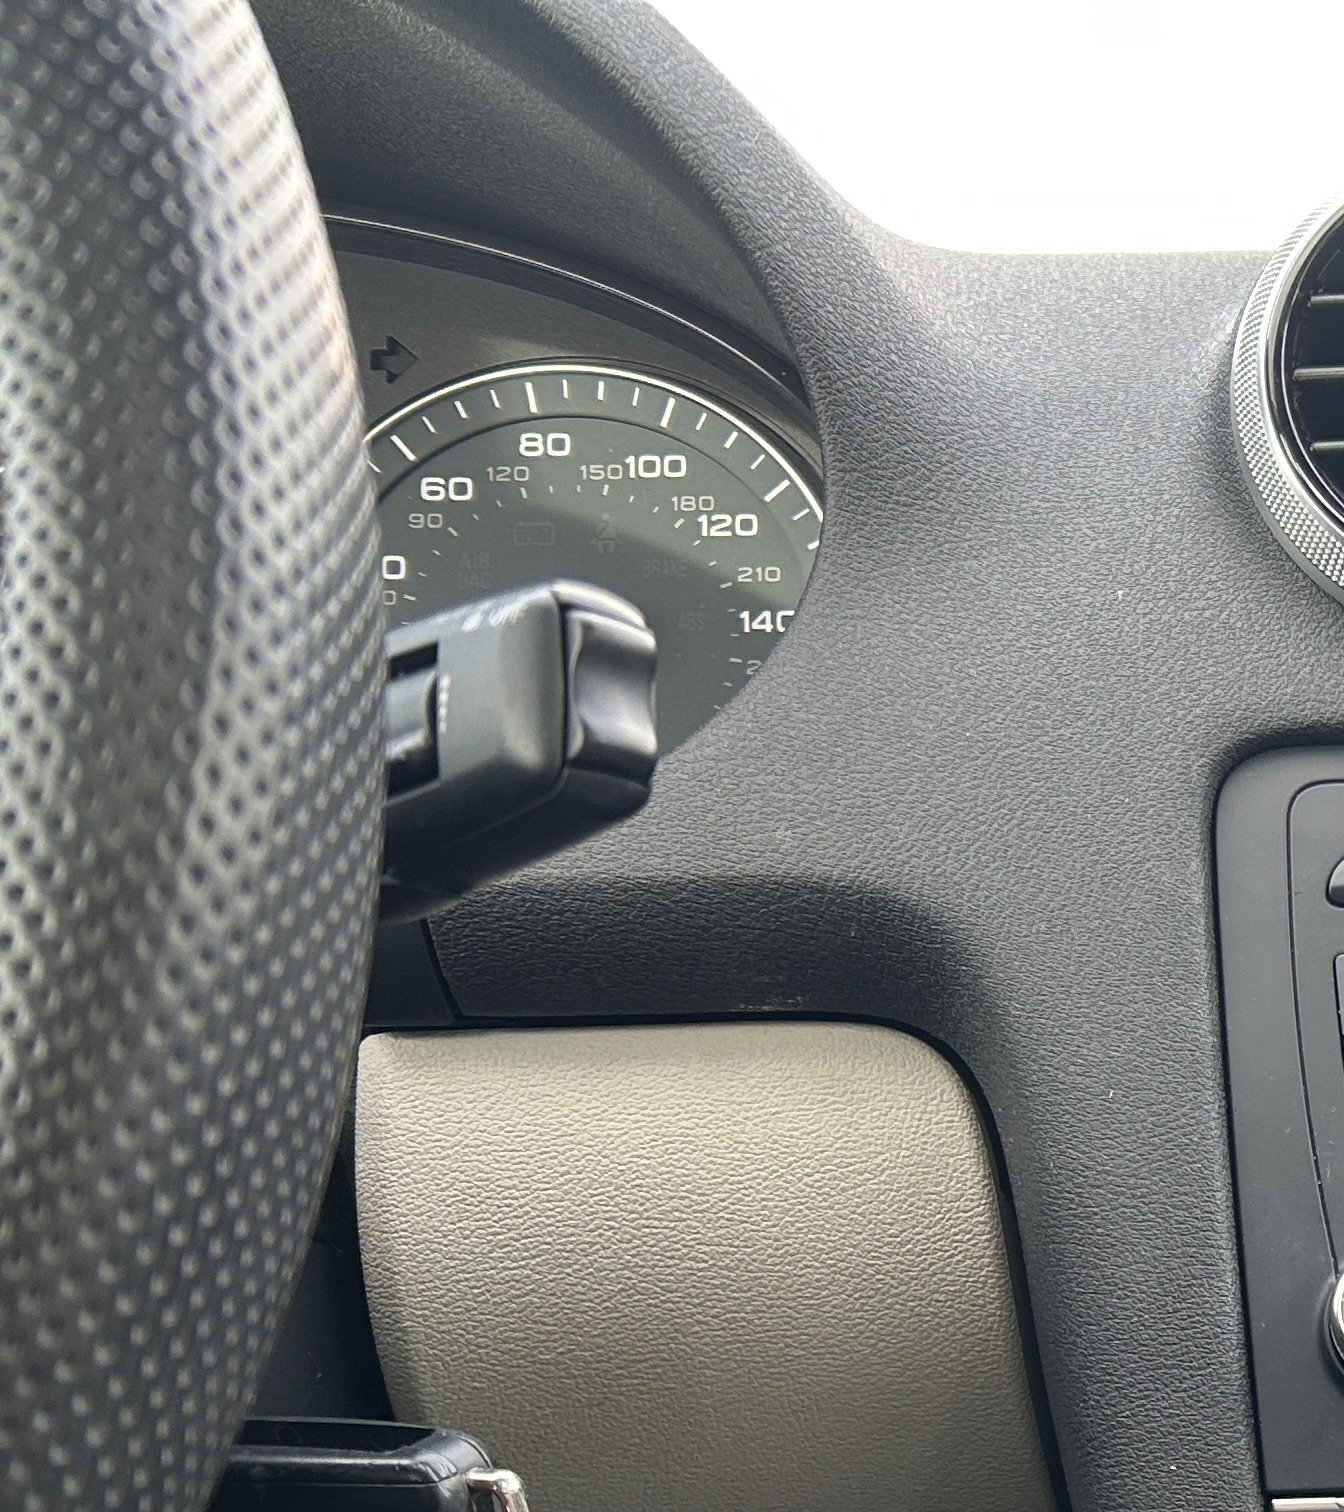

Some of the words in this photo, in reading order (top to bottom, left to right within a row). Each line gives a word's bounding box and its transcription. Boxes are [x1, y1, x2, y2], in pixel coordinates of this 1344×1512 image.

[519, 433, 571, 456] 80
[486, 466, 530, 482] 120
[580, 465, 623, 480] 150
[624, 455, 687, 478] 100
[420, 477, 473, 501] 60
[671, 496, 715, 511] 180
[408, 514, 443, 529] 90
[698, 514, 758, 536] 120
[737, 566, 781, 582] 210
